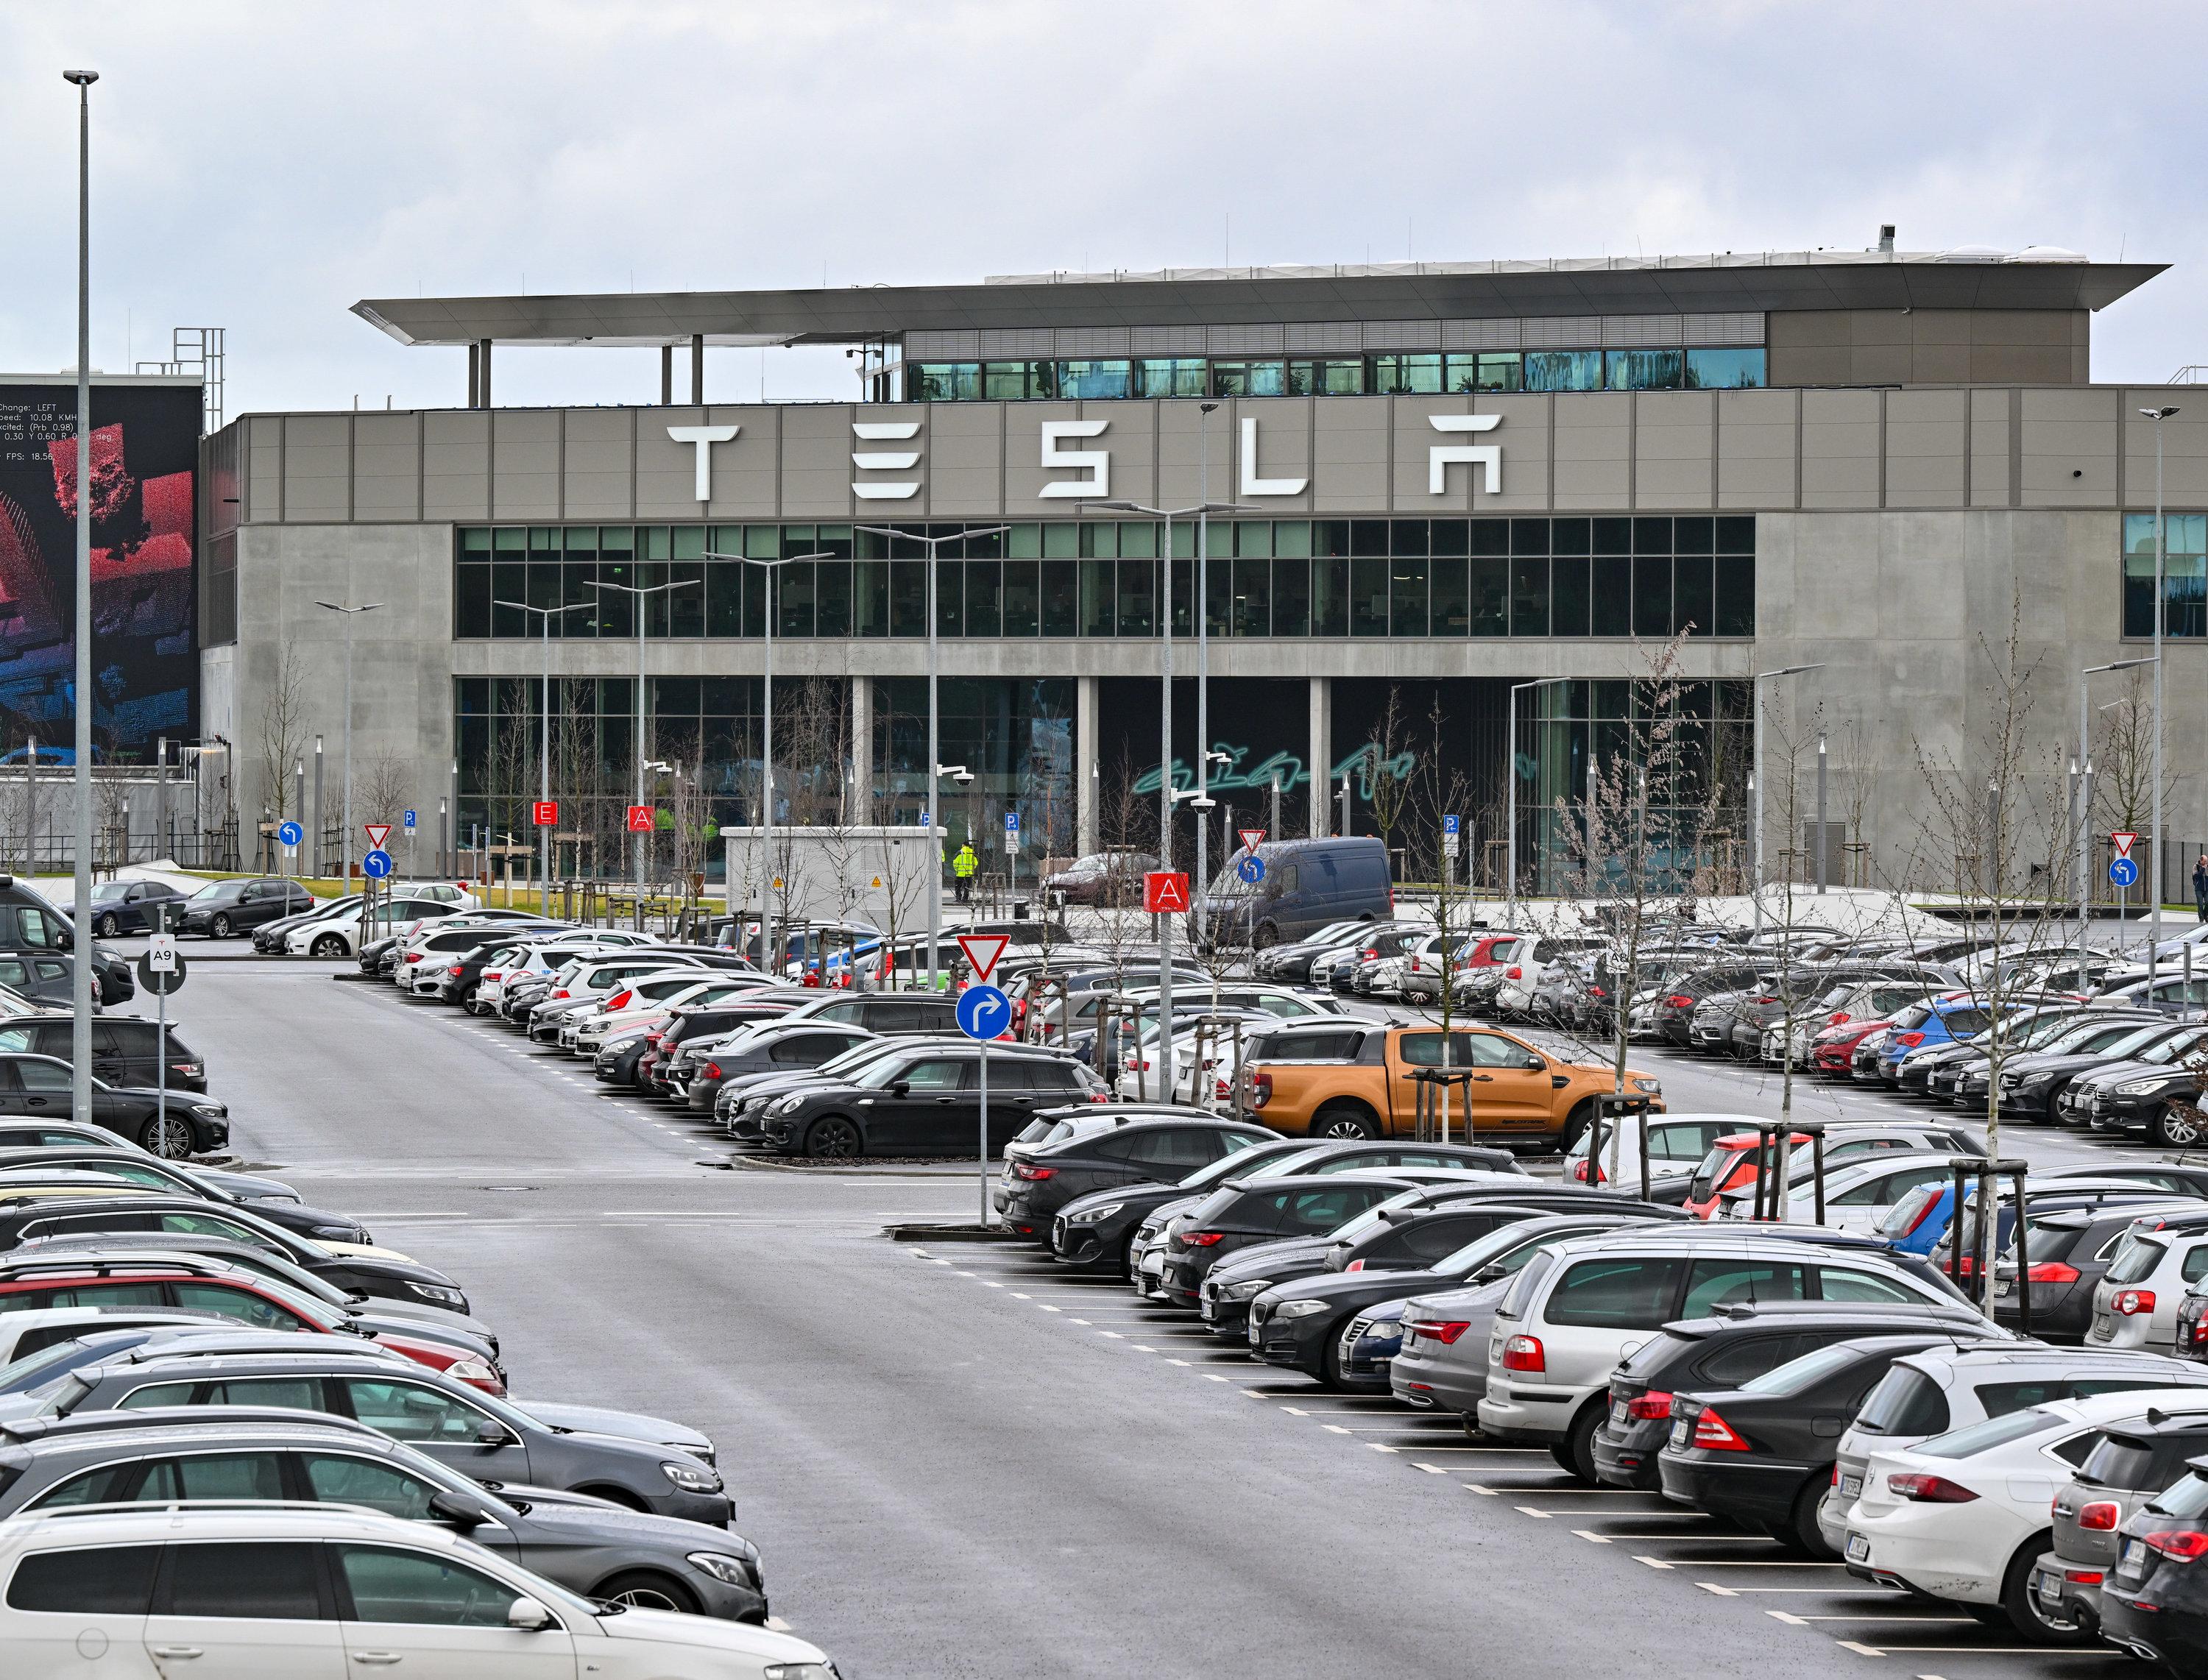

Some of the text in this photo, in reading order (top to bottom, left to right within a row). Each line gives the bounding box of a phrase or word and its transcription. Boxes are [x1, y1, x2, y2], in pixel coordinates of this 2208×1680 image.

[38, 403, 57, 411] LEFT
[29, 422, 46, 433] (Prb
[52, 422, 74, 433] 0.98)
[96, 433, 112, 442] deg
[666, 414, 1504, 501] TESLA
[406, 812, 413, 825] P
[540, 805, 552, 820] E
[634, 809, 649, 826] A
[1008, 815, 1015, 829] P
[1446, 818, 1454, 831] P
[1156, 879, 1181, 904] A
[153, 950, 171, 961] A9
